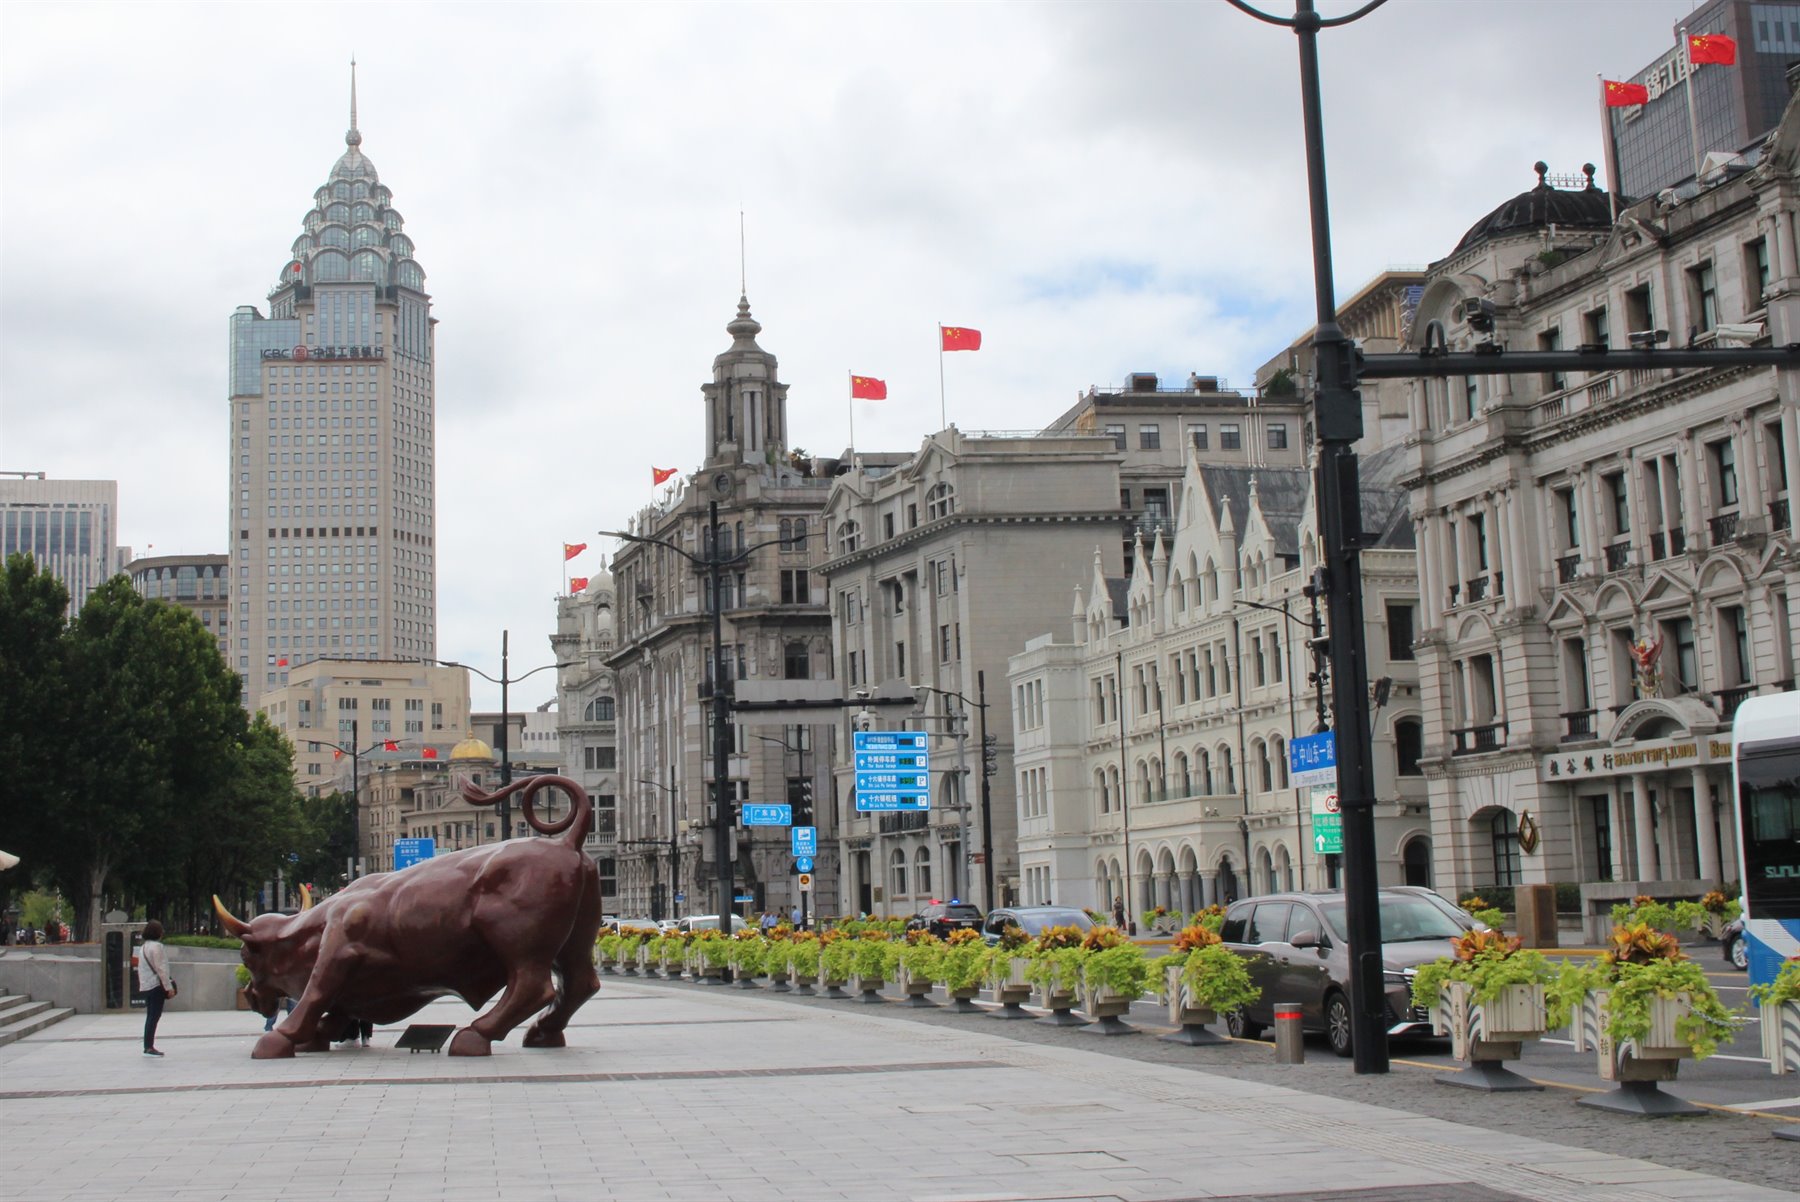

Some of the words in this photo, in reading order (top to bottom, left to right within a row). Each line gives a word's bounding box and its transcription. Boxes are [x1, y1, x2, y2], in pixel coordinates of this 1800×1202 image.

[260, 348, 290, 359] ICBC
[313, 345, 384, 359] 中国工商银行
